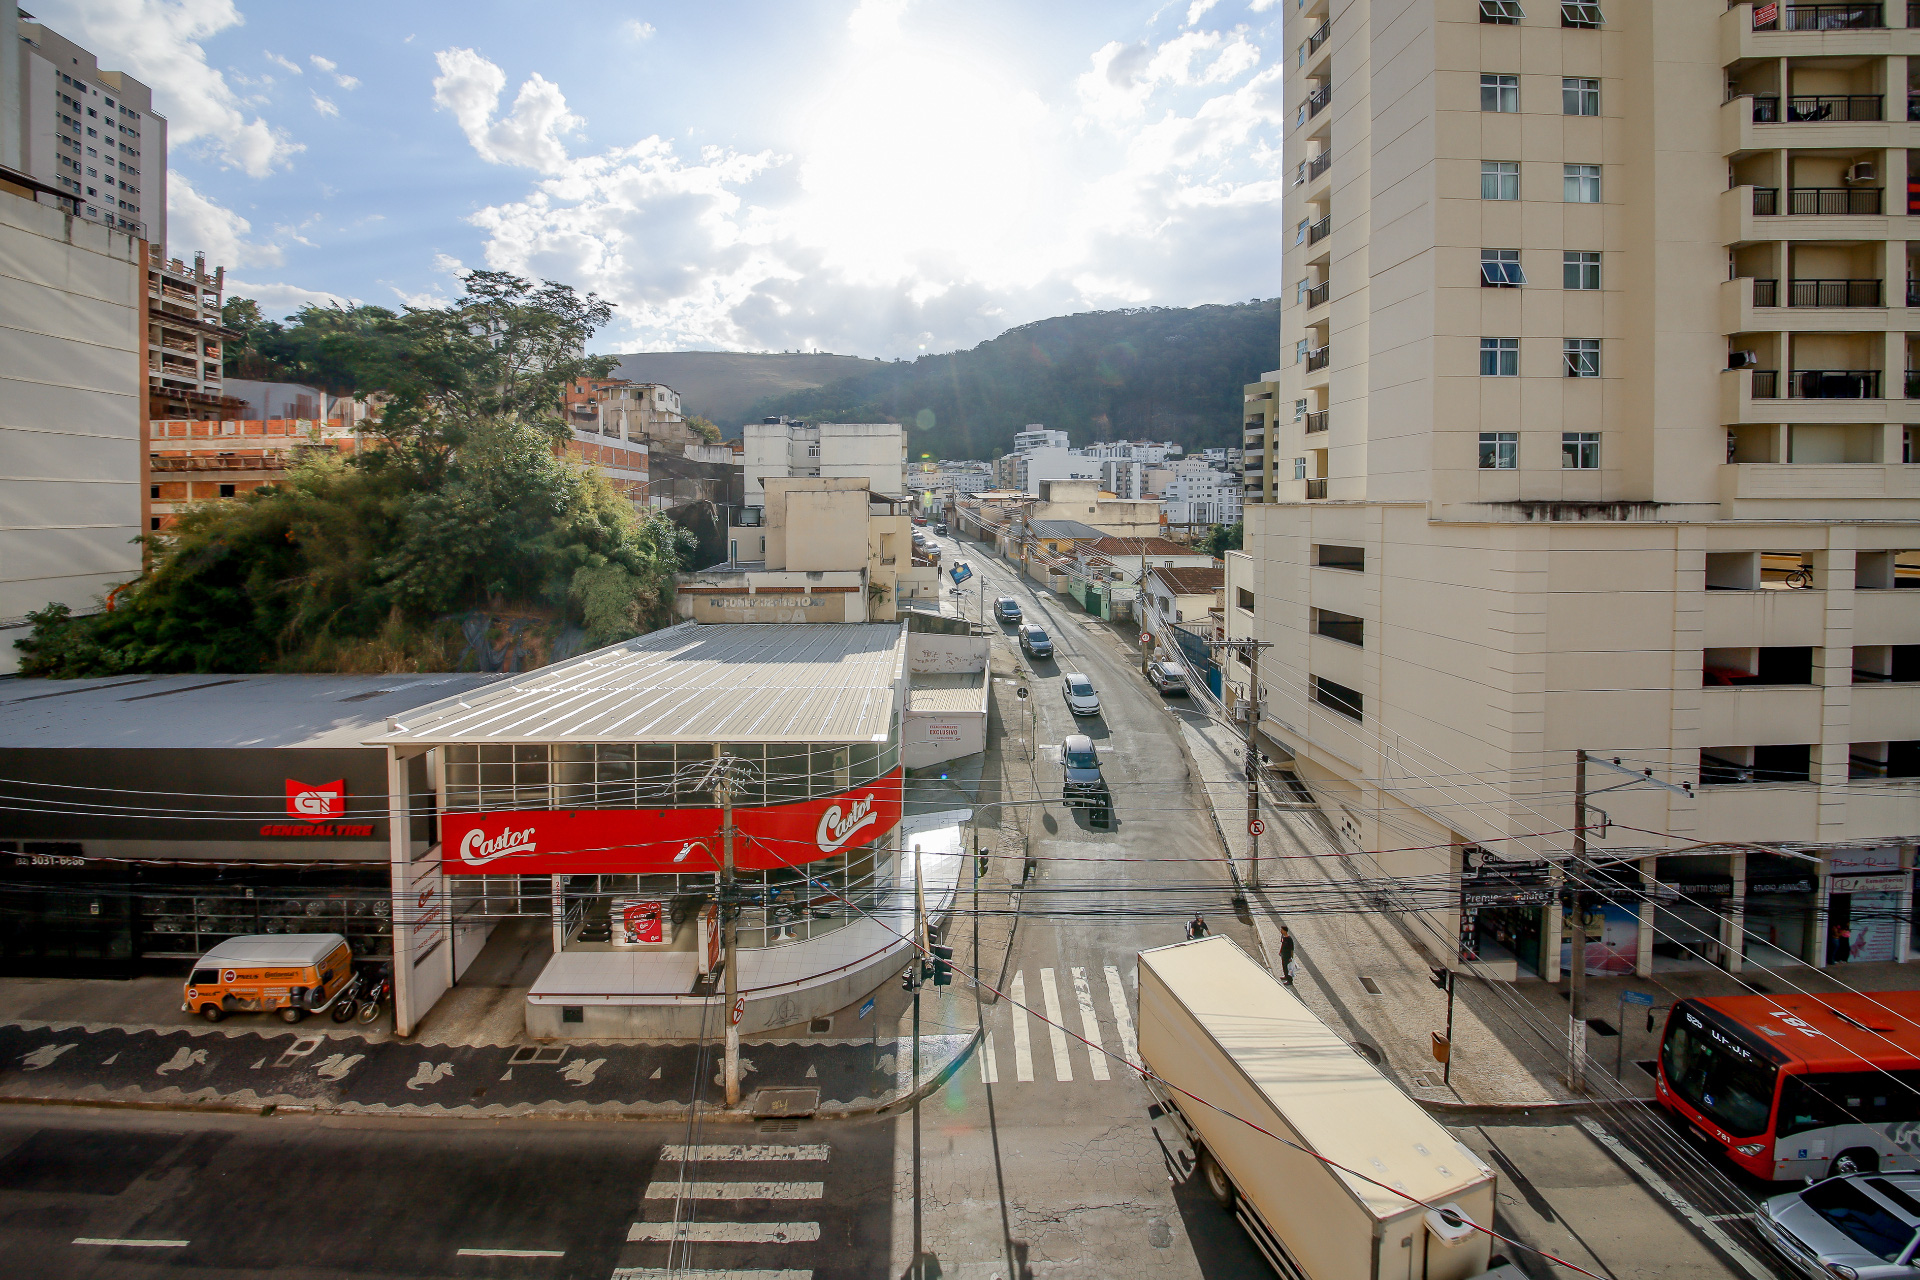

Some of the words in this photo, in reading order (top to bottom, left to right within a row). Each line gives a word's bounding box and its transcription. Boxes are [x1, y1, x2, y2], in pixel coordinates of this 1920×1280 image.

[294, 791, 338, 815] GT
[260, 825, 335, 836] GENERAL
[336, 825, 374, 836] TIRE
[816, 793, 878, 853] Castor
[460, 826, 537, 866] Castor
[1716, 1129, 1731, 1143] 781
